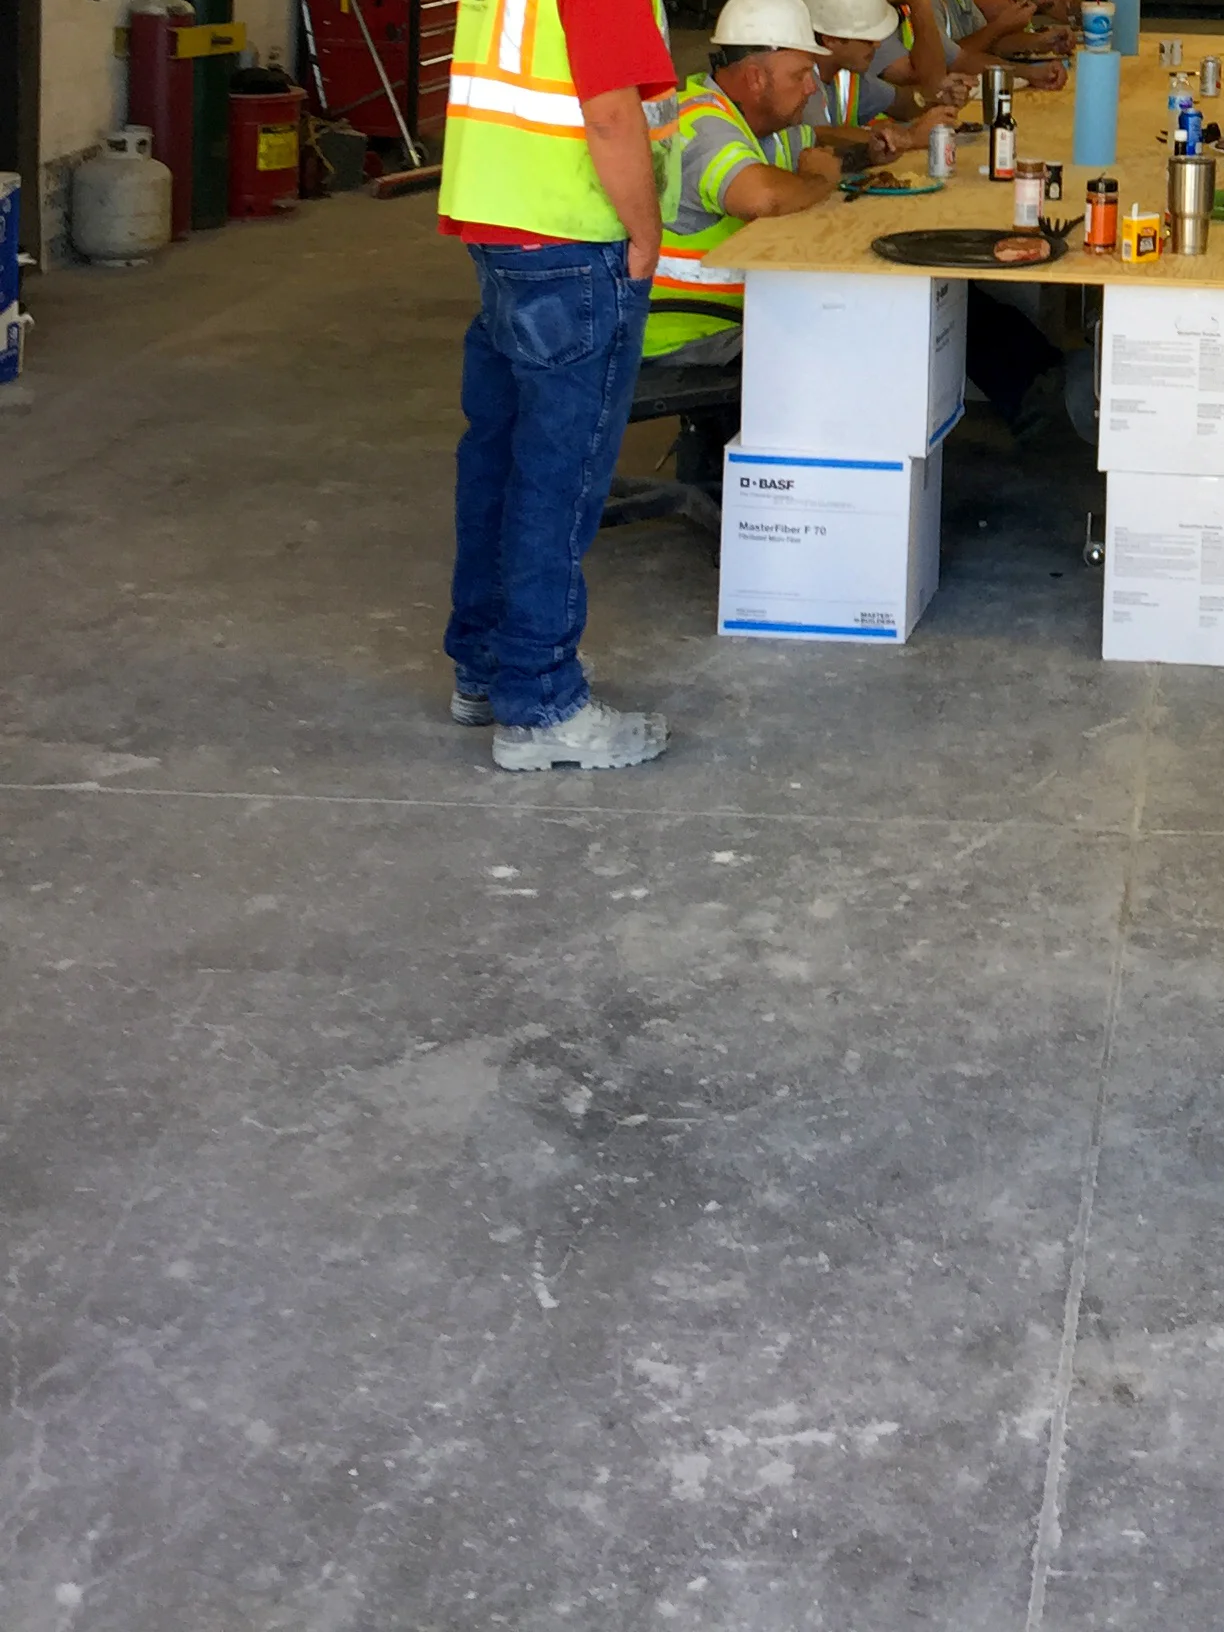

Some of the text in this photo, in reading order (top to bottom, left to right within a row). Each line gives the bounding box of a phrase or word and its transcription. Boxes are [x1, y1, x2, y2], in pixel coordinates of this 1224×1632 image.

[759, 478, 795, 491] BASF
[738, 521, 827, 536] MasterFiber F 70
